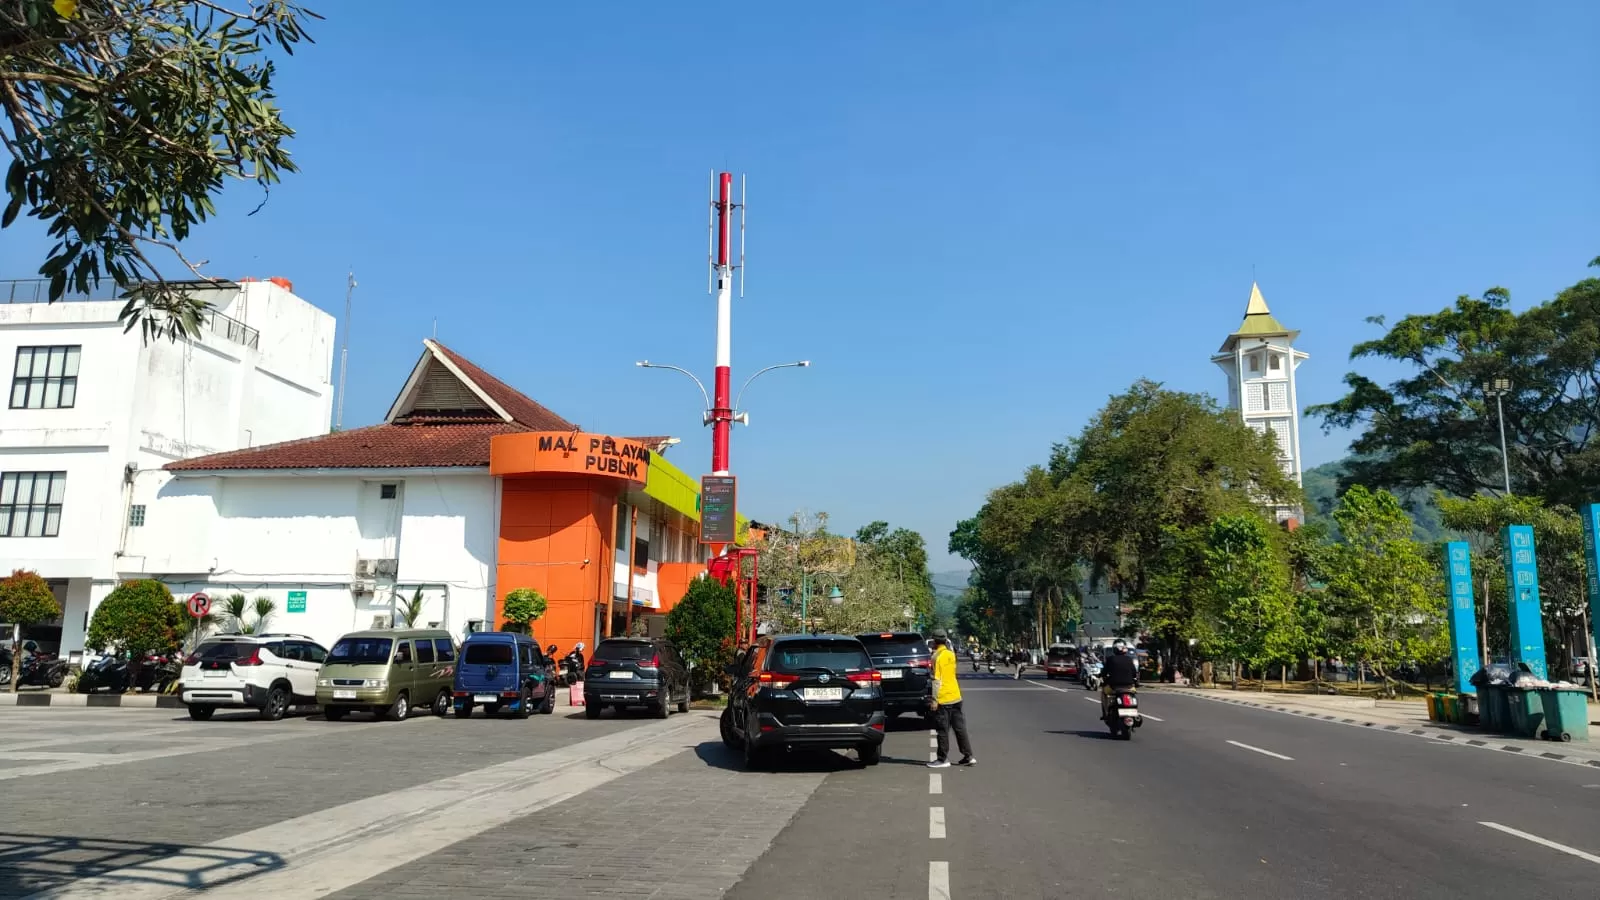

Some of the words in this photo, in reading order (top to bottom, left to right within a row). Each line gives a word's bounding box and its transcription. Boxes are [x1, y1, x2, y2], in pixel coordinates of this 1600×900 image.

[539, 436, 578, 452] MAL
[586, 456, 638, 477] PUBLIK
[195, 597, 207, 612] P
